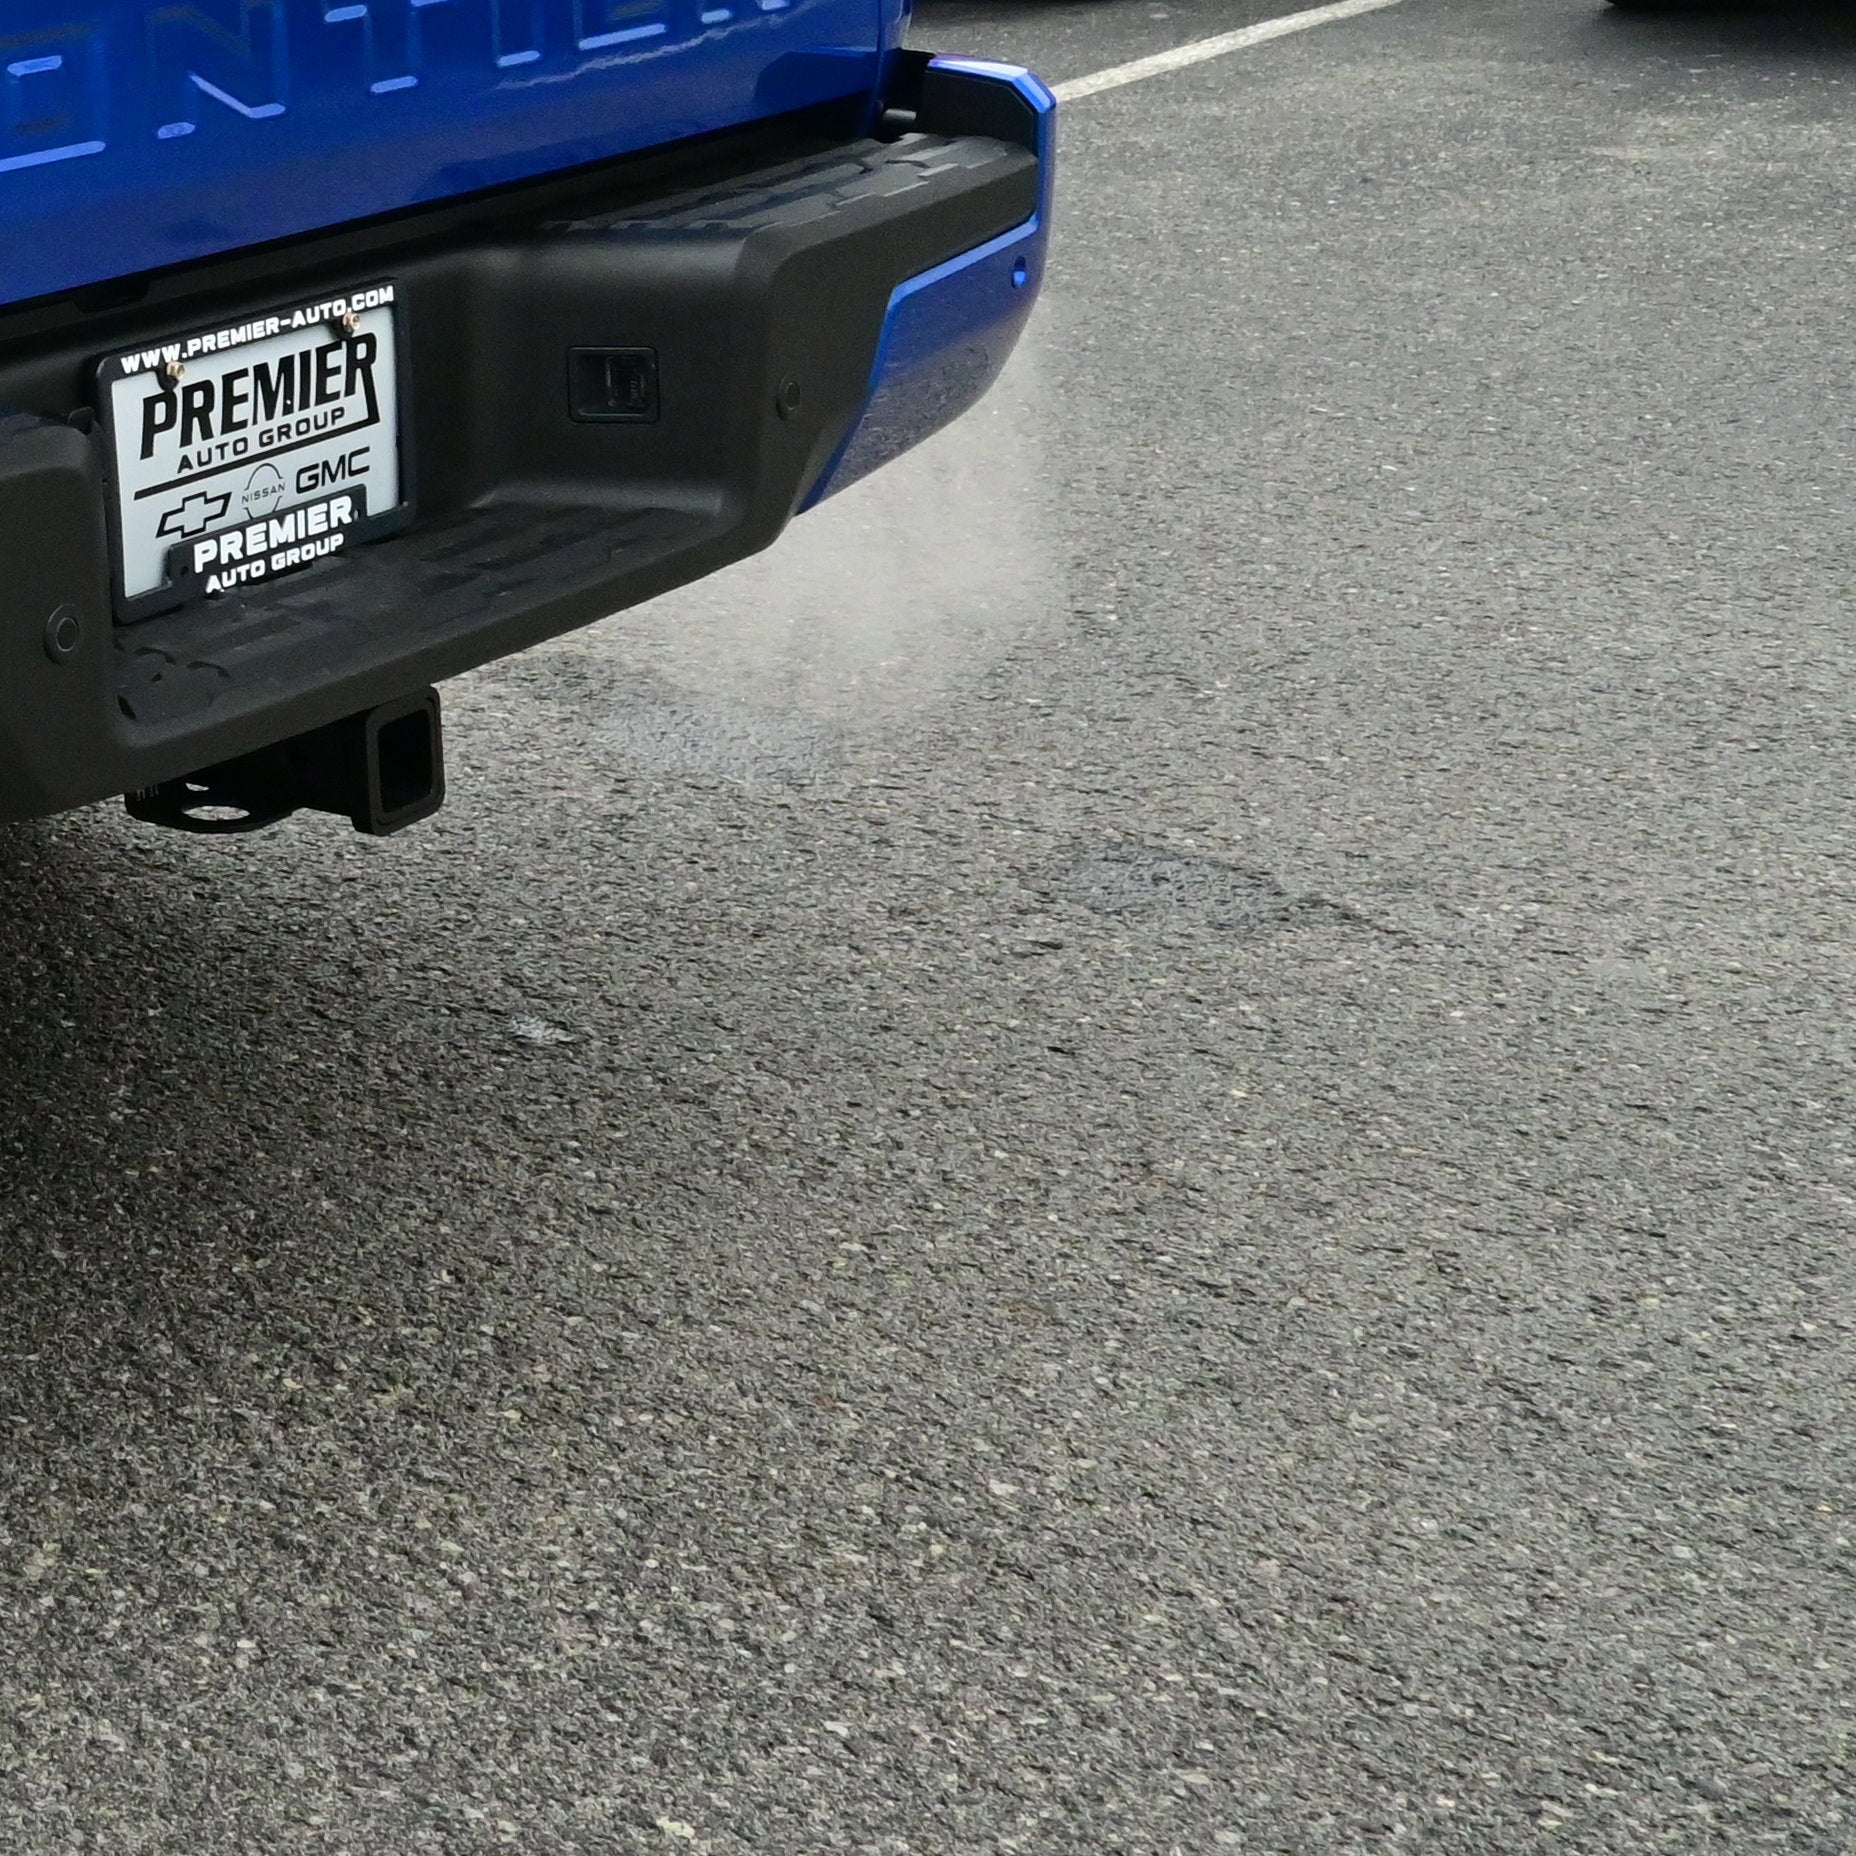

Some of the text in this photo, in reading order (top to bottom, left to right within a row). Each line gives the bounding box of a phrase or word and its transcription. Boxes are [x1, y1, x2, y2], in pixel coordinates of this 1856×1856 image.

[120, 285, 395, 375] WWW.PREMIER-AUTO.COM
[140, 330, 381, 462] PREMIER
[176, 406, 347, 475] AUTO GROUP
[294, 446, 372, 495] GMC
[241, 481, 287, 505] NISSAN
[192, 494, 354, 575] PREMIER
[204, 532, 346, 595] AUTO GROUP
